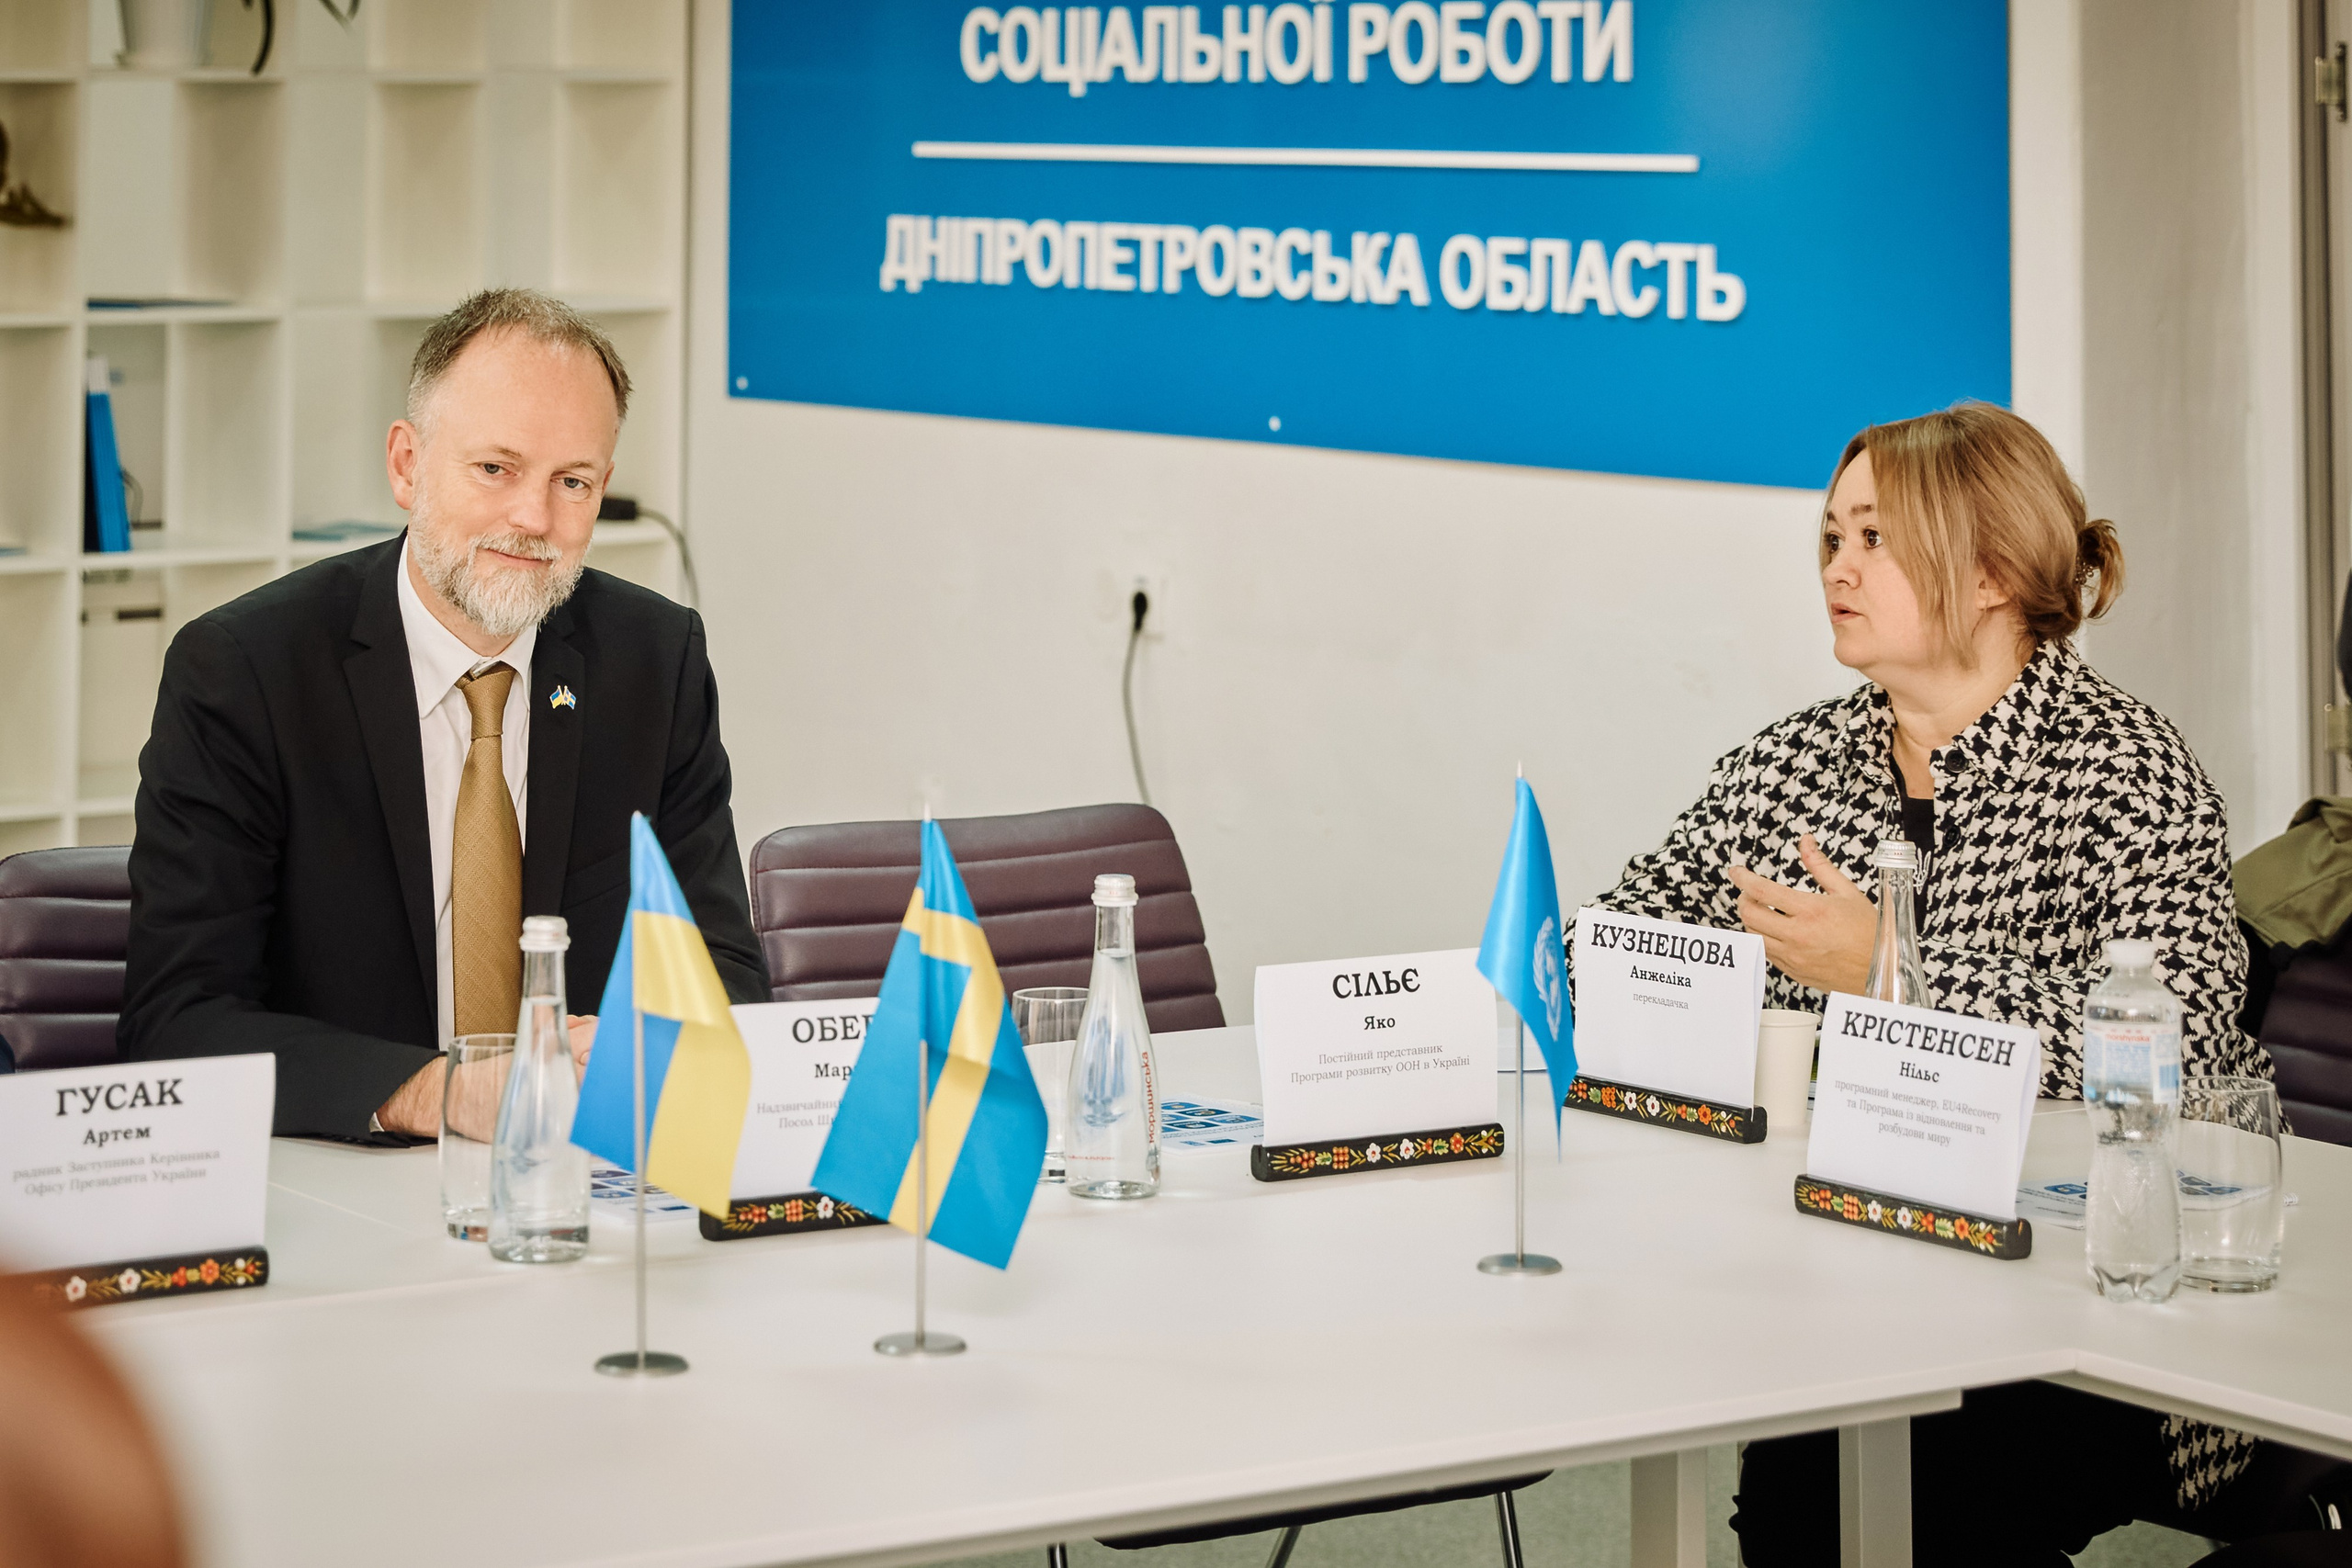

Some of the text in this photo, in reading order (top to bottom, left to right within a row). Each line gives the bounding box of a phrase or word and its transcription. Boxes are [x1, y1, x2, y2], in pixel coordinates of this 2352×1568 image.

[1348, 0, 1634, 85] РОБОТИ
[880, 215, 1747, 322] ДНІПРОПЕТРОВСЬКА ОБЛАСТЬ
[1591, 923, 1735, 968] КУЗНЕЦОВА
[1332, 968, 1420, 998] СІЛЬЄ
[1630, 965, 1691, 987] Анжеліка
[1633, 993, 1689, 1010] перекладачка
[1363, 1015, 1396, 1030] Яко
[1841, 1010, 2016, 1066] КРІСТЕНСЕН
[1318, 1044, 1443, 1064] Постійний представник
[814, 1063, 853, 1080] Мар
[1291, 1069, 1342, 1085] Програми
[1346, 1064, 1394, 1079] розвитку
[1396, 1060, 1420, 1072] ООН
[1432, 1055, 1470, 1070] Україні
[1899, 1061, 1939, 1083] Нільс
[55, 1078, 184, 1116] ГУСАК
[757, 1100, 842, 1114] Надзвичайни
[1835, 1079, 1889, 1099] програмний
[1942, 1100, 2001, 1122] EU4Recovery
[779, 1117, 813, 1129] Посол
[1847, 1099, 1985, 1134] та Програма із відновлення та
[83, 1126, 151, 1147] Артем
[1878, 1122, 1951, 1146] розбудови миру
[68, 1156, 145, 1174] Заступника
[150, 1149, 220, 1166] Керівника
[25, 1167, 206, 1196] Офісу Президента України
